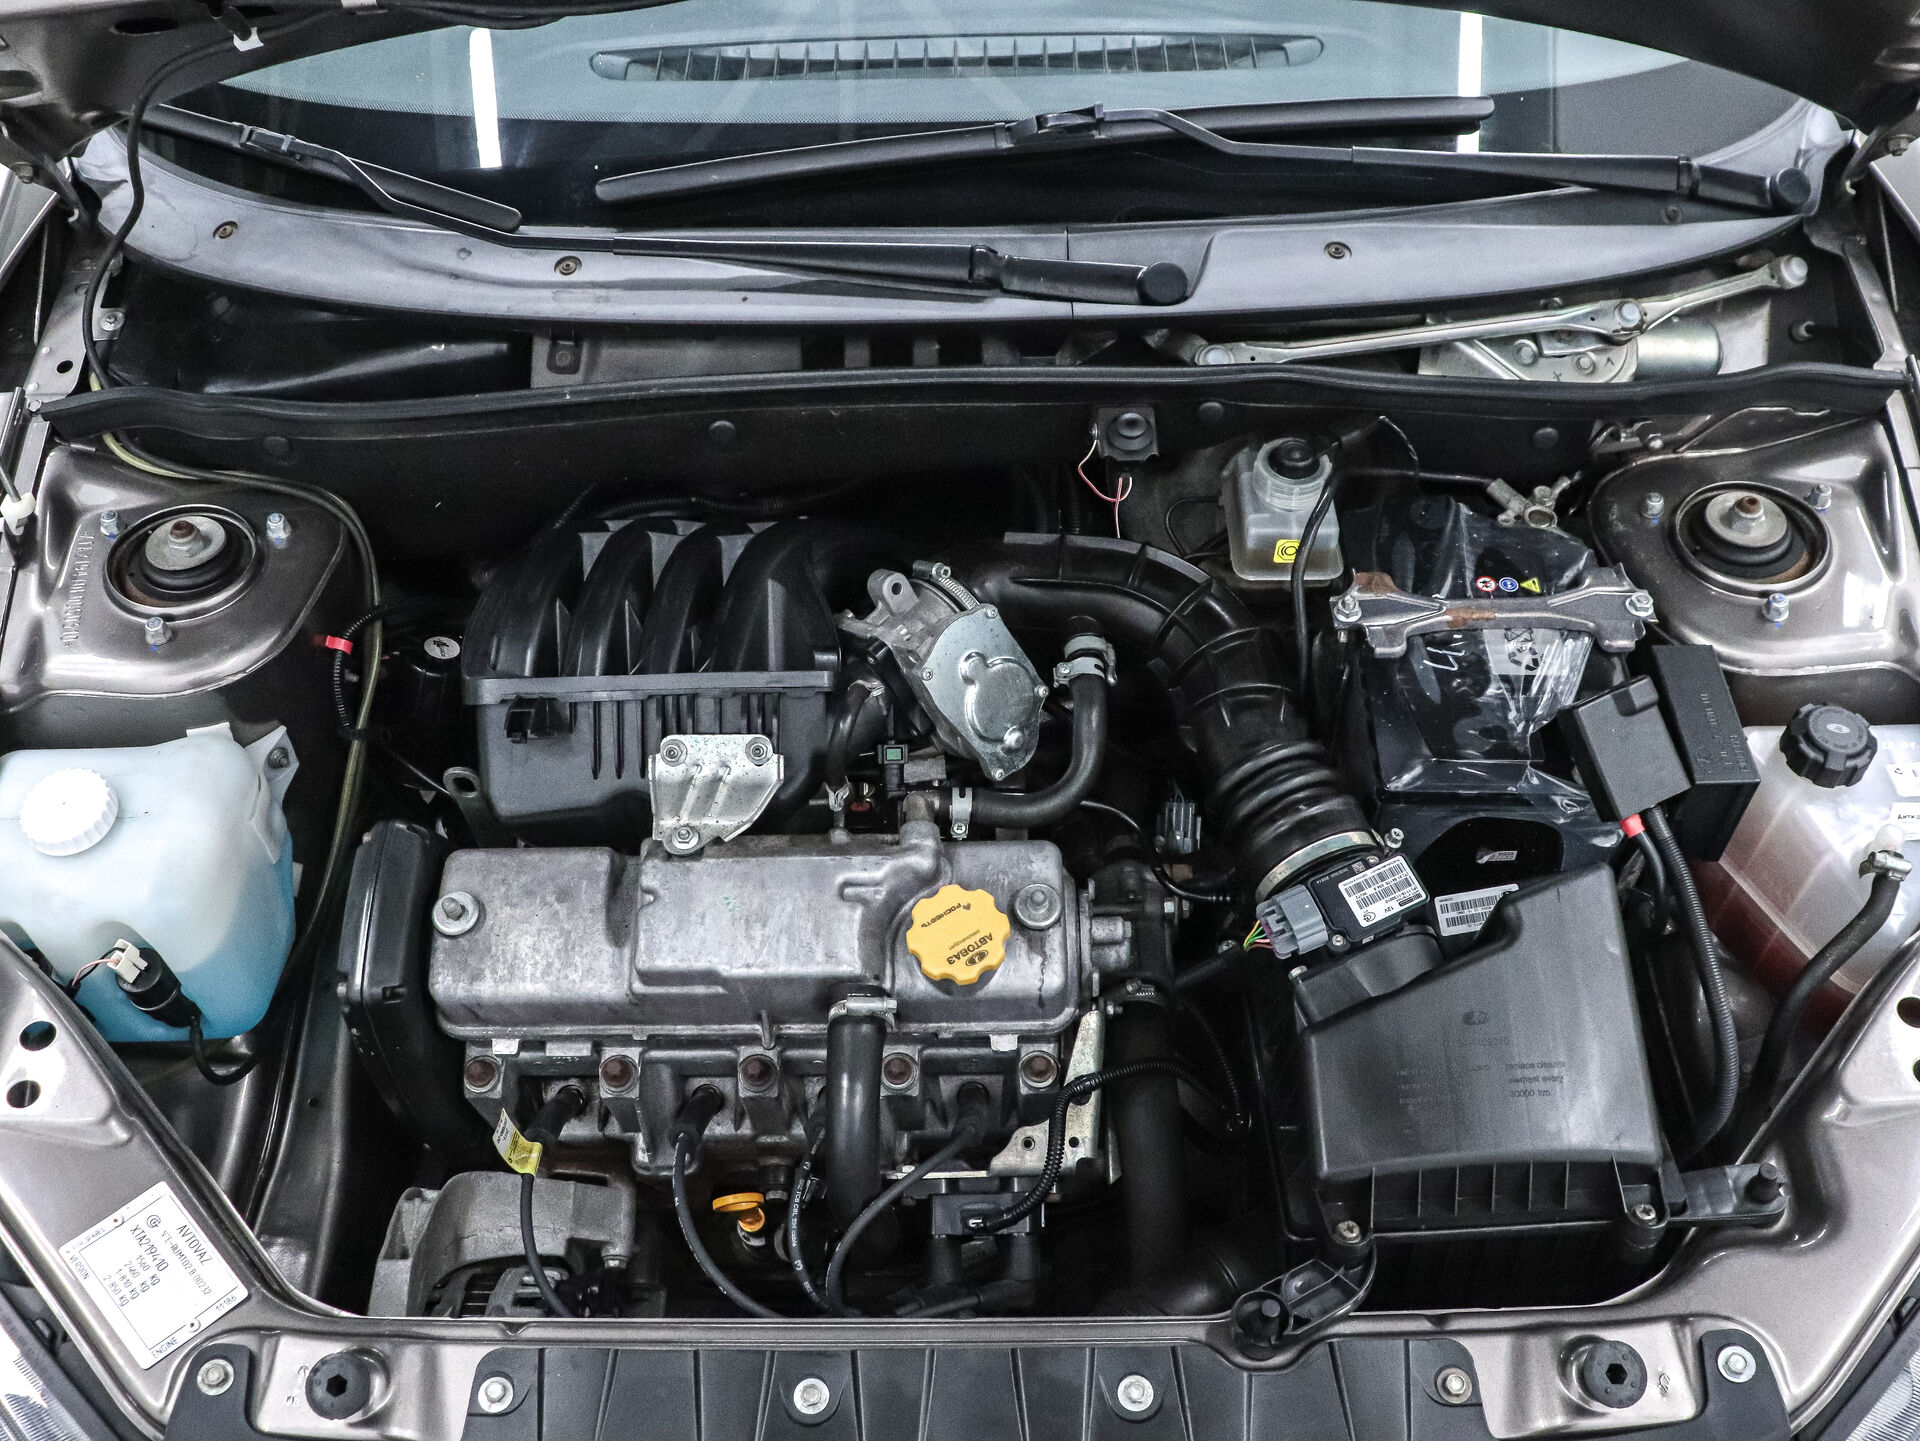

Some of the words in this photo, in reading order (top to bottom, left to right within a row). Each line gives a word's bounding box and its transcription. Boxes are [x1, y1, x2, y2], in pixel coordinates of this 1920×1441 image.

[920, 902, 962, 928] РОСНЕФТЬ
[1384, 906, 1394, 914] 12V
[946, 932, 993, 965] АВТОВАЗ
[129, 1224, 169, 1272] XTA219410
[176, 1224, 213, 1266] AVTOVAZ
[69, 1255, 91, 1280] VERSION
[136, 1254, 151, 1272] 1560
[794, 1260, 803, 1271] 3
[215, 1294, 237, 1312] 11186
[151, 1336, 179, 1359] ENGINE
